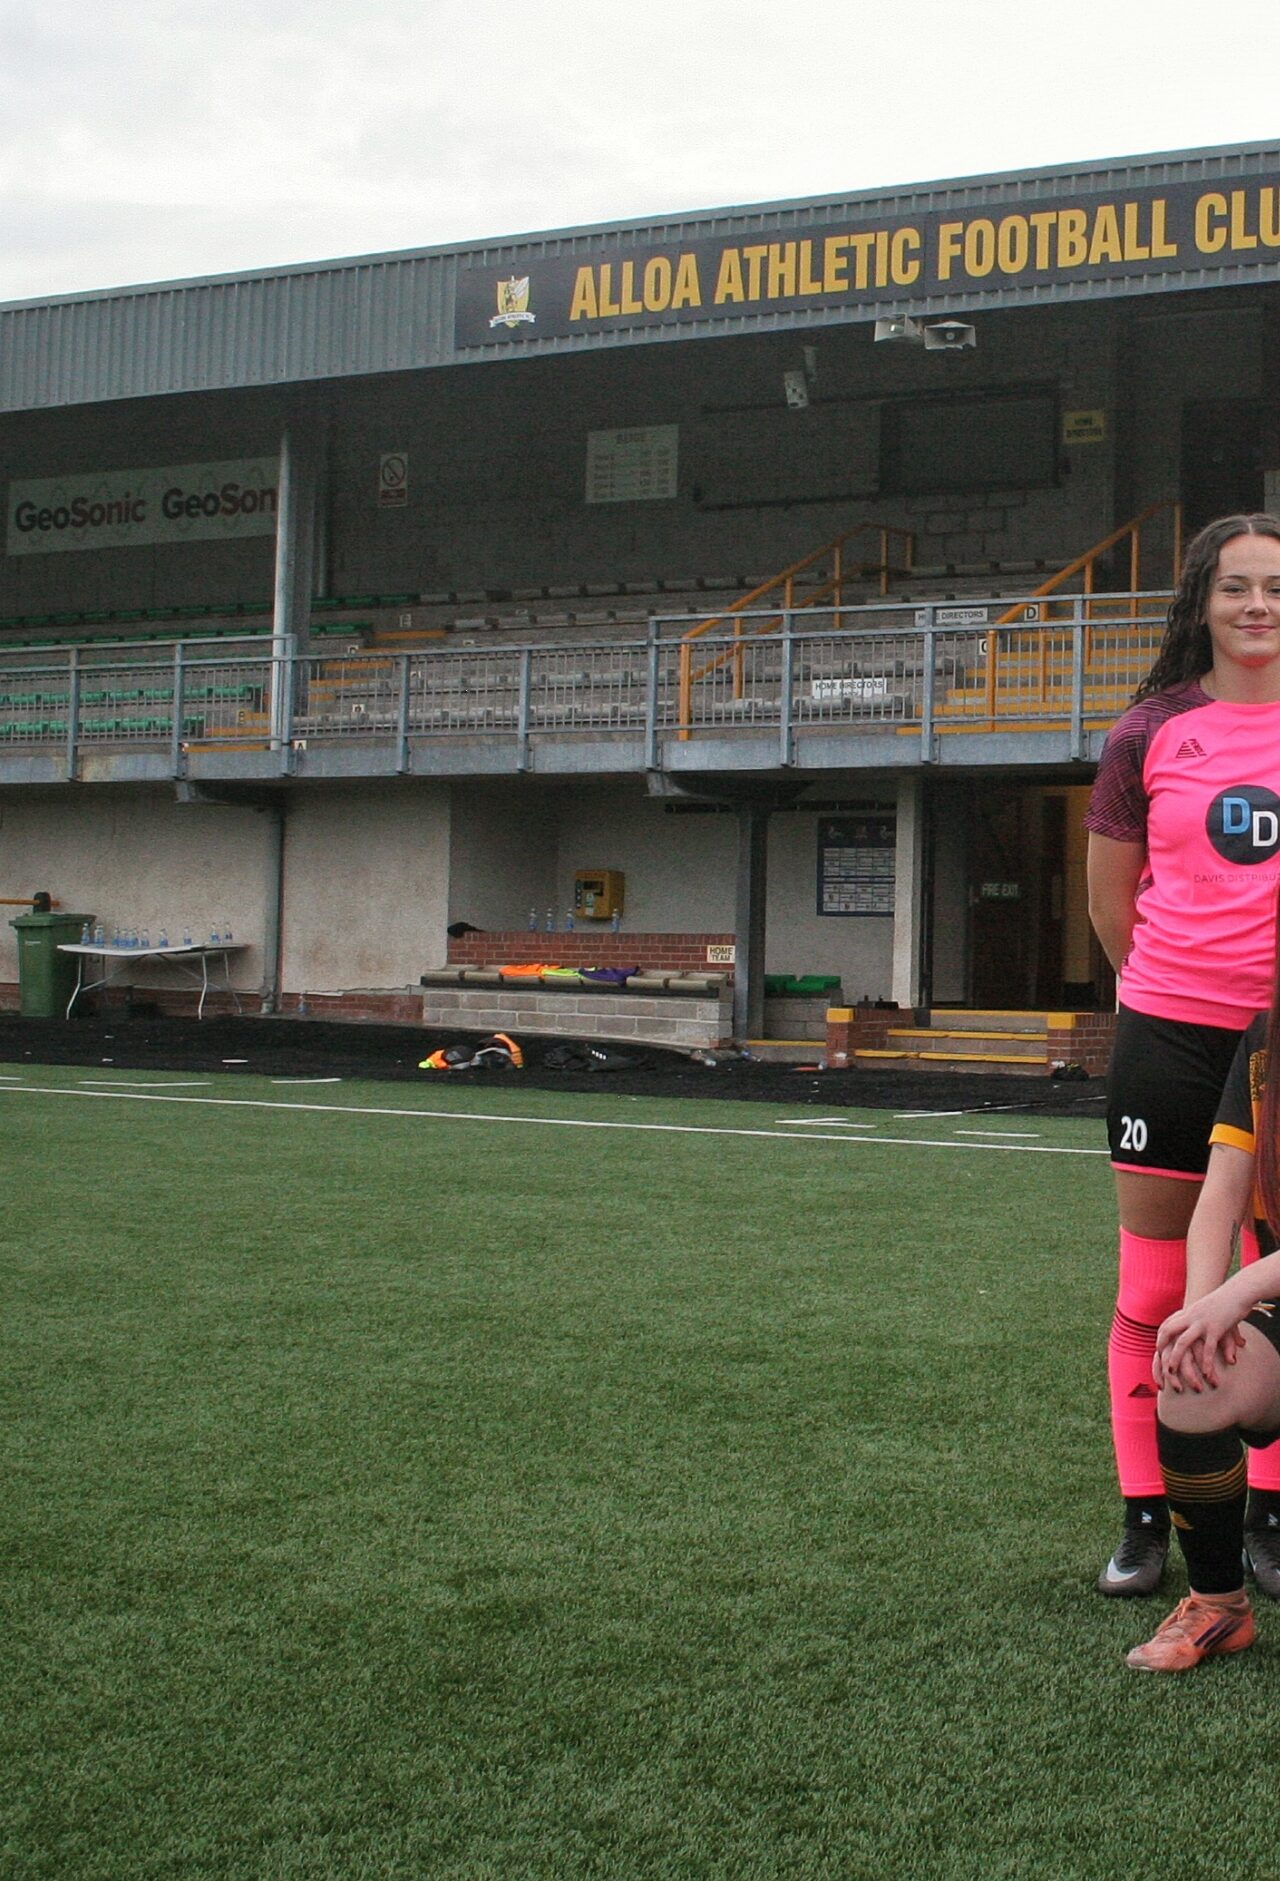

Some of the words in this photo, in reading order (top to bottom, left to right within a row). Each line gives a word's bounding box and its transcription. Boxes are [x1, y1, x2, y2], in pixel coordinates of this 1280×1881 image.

[569, 253, 702, 322] ALLOA
[714, 226, 922, 305] ATHLETIC
[938, 199, 1178, 281] FOOTBALL
[15, 491, 147, 533] GeoSonic
[161, 482, 279, 521] GeoSon
[941, 609, 984, 620] DIRECTORS
[1194, 873, 1225, 883] DAVIS
[710, 946, 734, 955] HOME
[1120, 1115, 1148, 1152] 20
